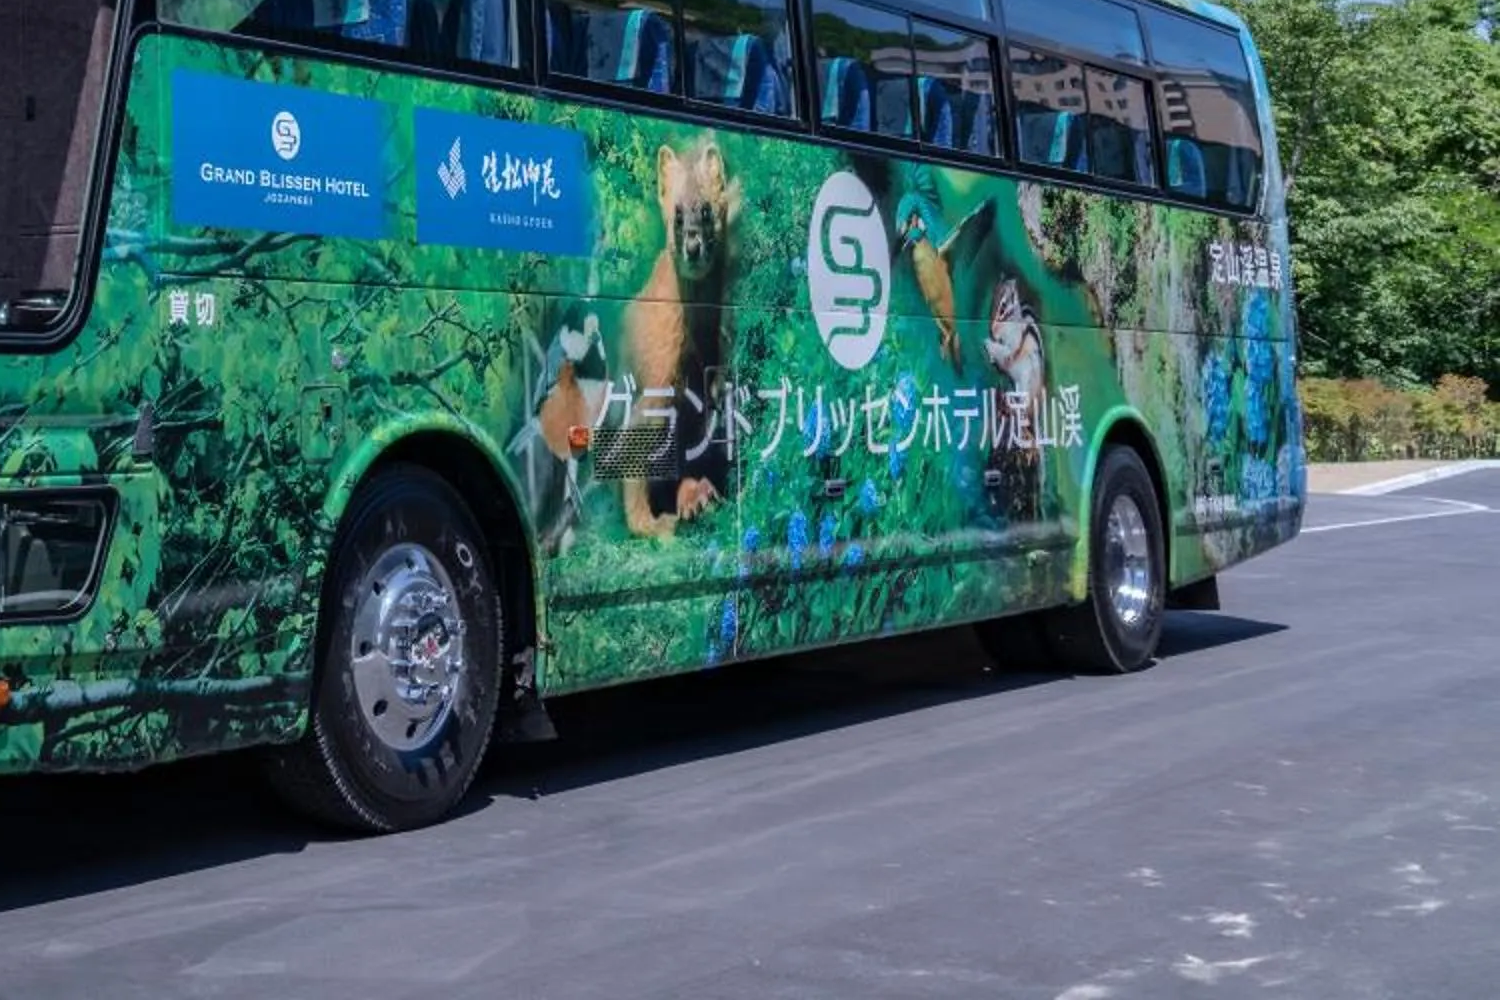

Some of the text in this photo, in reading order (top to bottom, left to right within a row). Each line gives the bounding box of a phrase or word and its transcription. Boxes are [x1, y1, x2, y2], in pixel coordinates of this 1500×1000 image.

[200, 162, 370, 198] GRAND BLISSEN HOTEL
